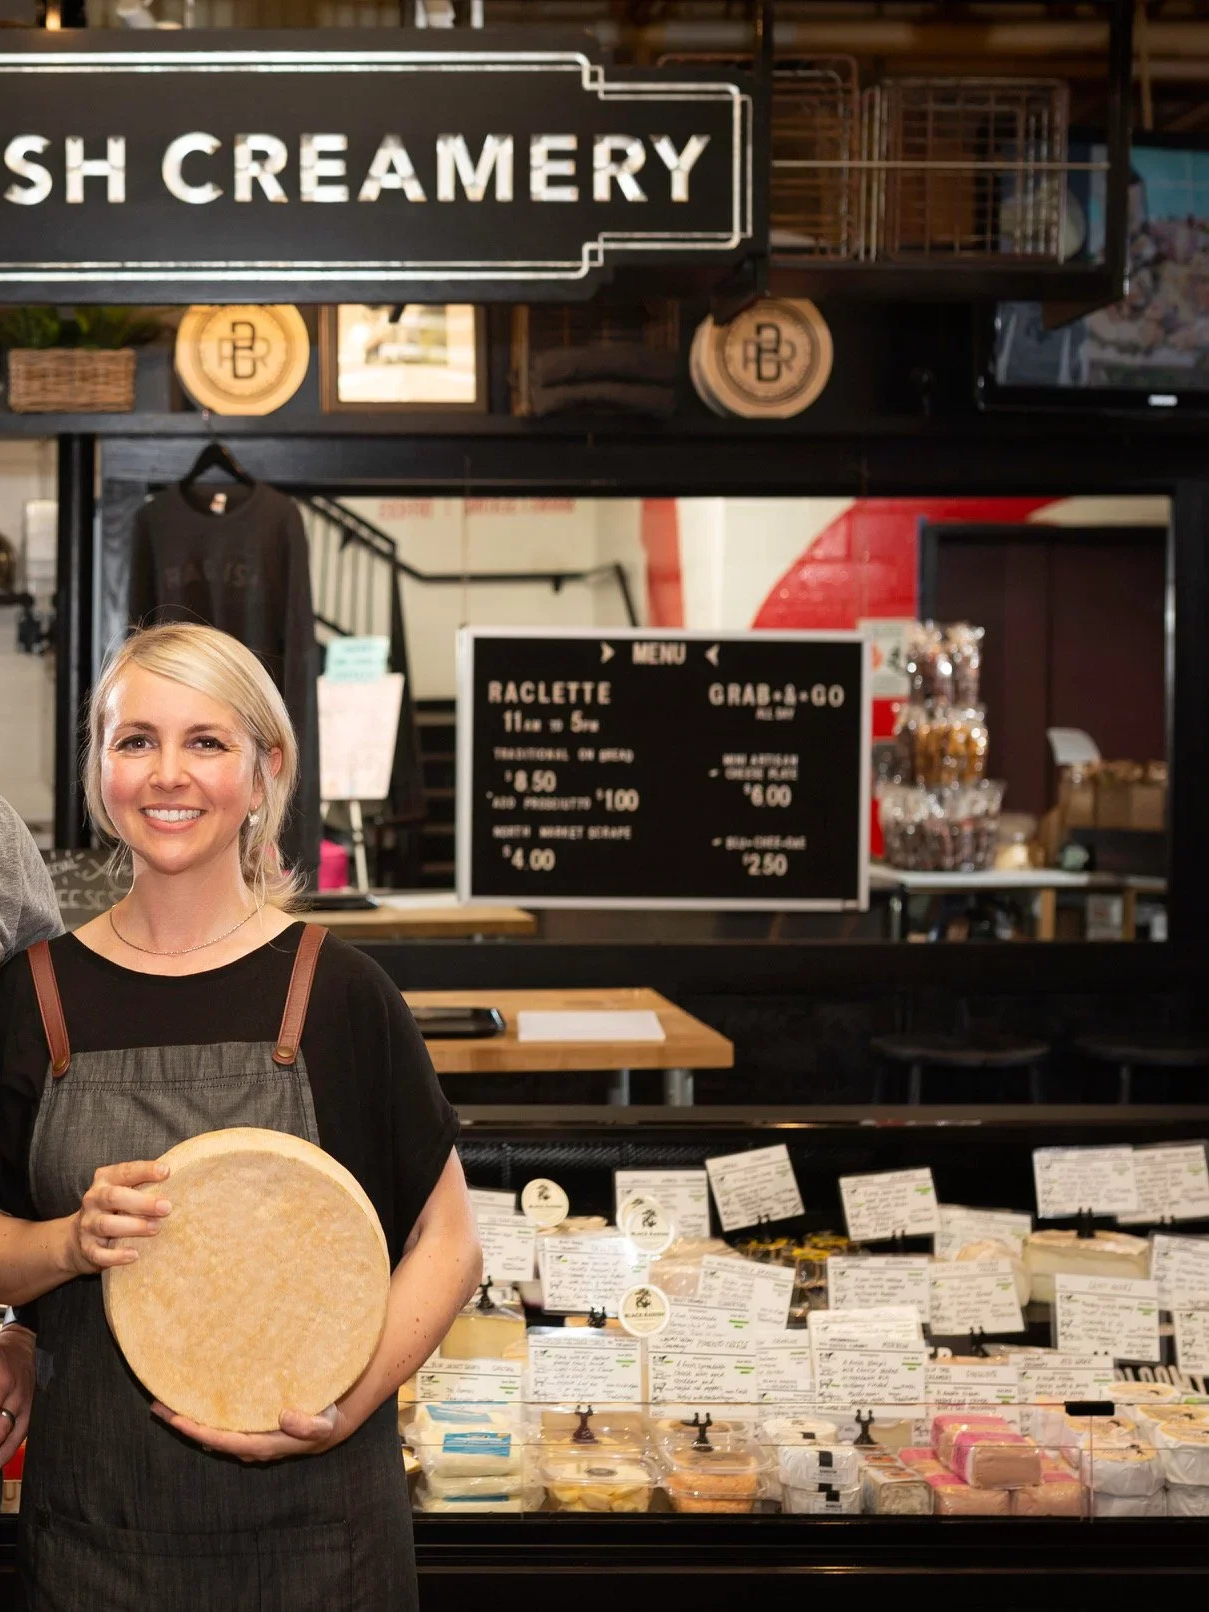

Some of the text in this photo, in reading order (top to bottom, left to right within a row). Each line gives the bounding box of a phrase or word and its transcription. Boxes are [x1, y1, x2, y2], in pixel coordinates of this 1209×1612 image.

[161, 133, 711, 206] CREAMERY
[632, 642, 687, 666] MENU
[488, 681, 611, 705] RACLETTE
